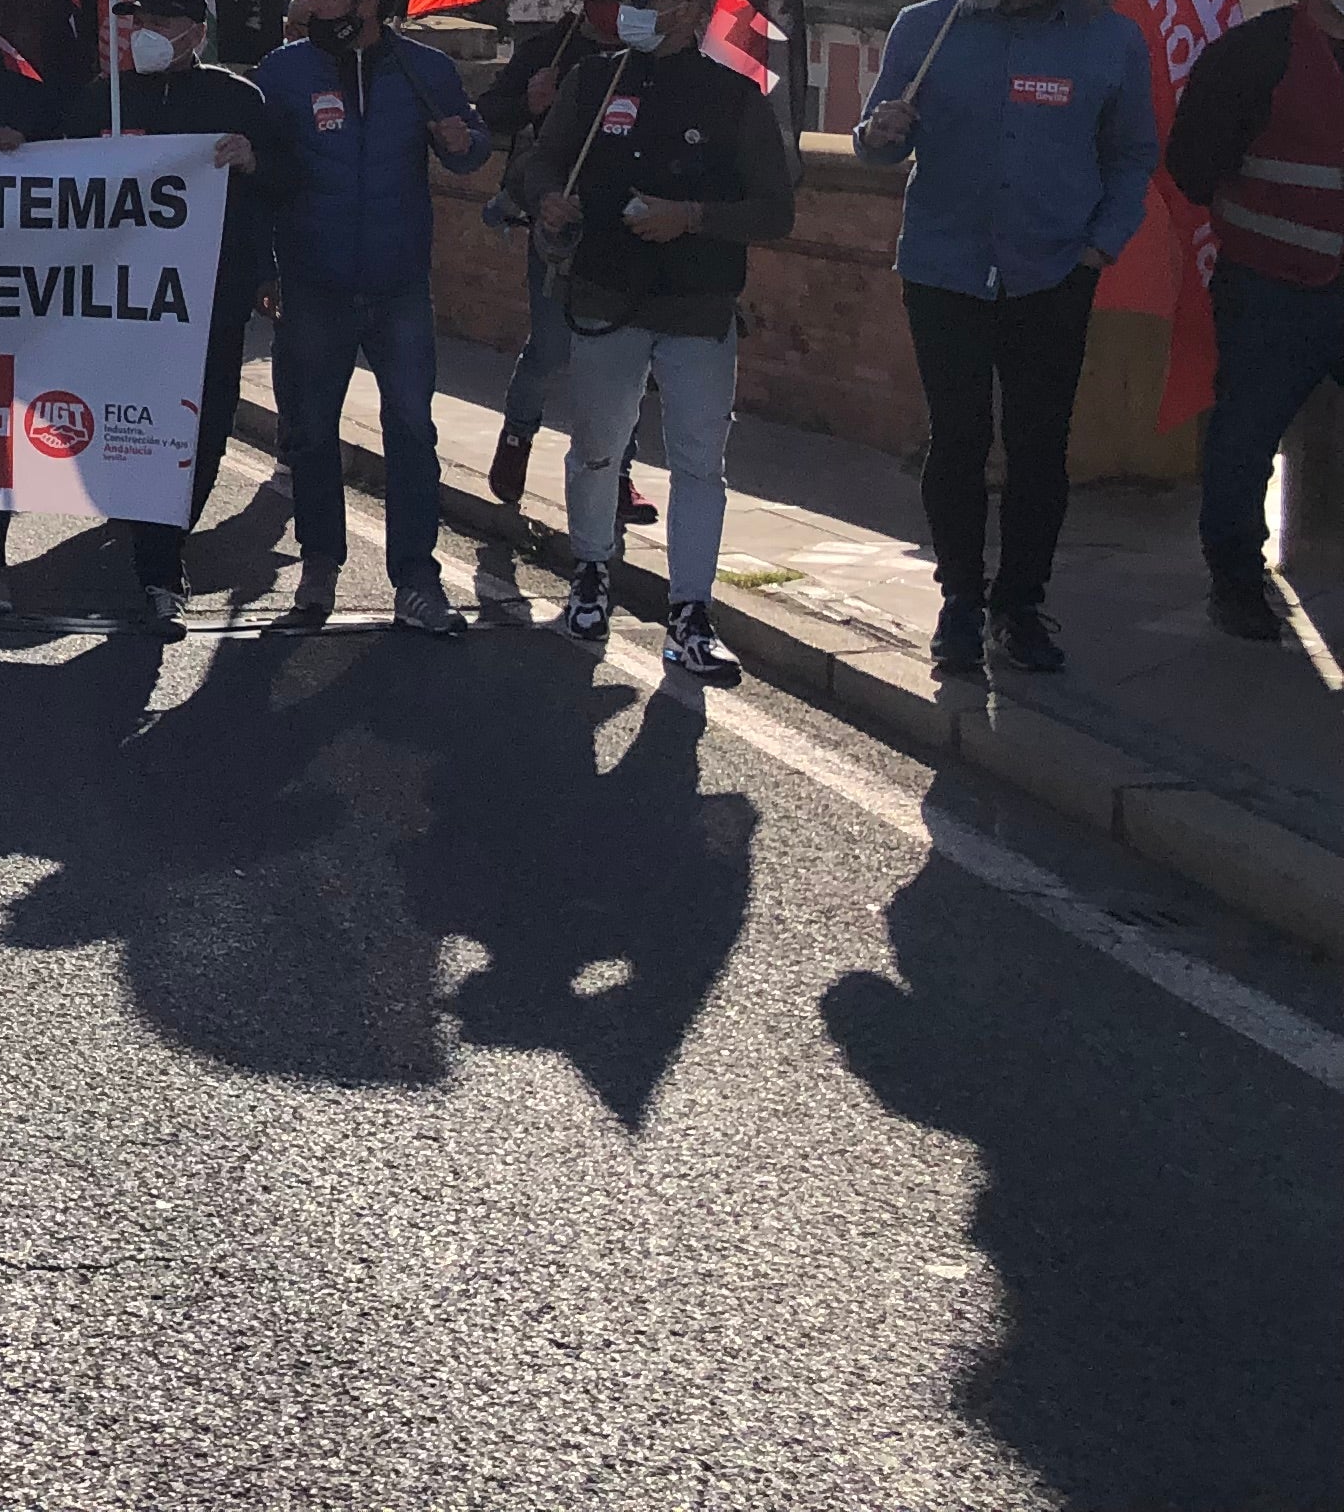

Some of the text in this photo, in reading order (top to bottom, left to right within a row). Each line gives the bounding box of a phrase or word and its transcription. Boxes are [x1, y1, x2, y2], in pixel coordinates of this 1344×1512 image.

[318, 119, 344, 131] CGT
[603, 124, 632, 136] CGT
[33, 400, 87, 428] UGT
[104, 403, 154, 426] FICA
[103, 443, 153, 455] Andalucía
